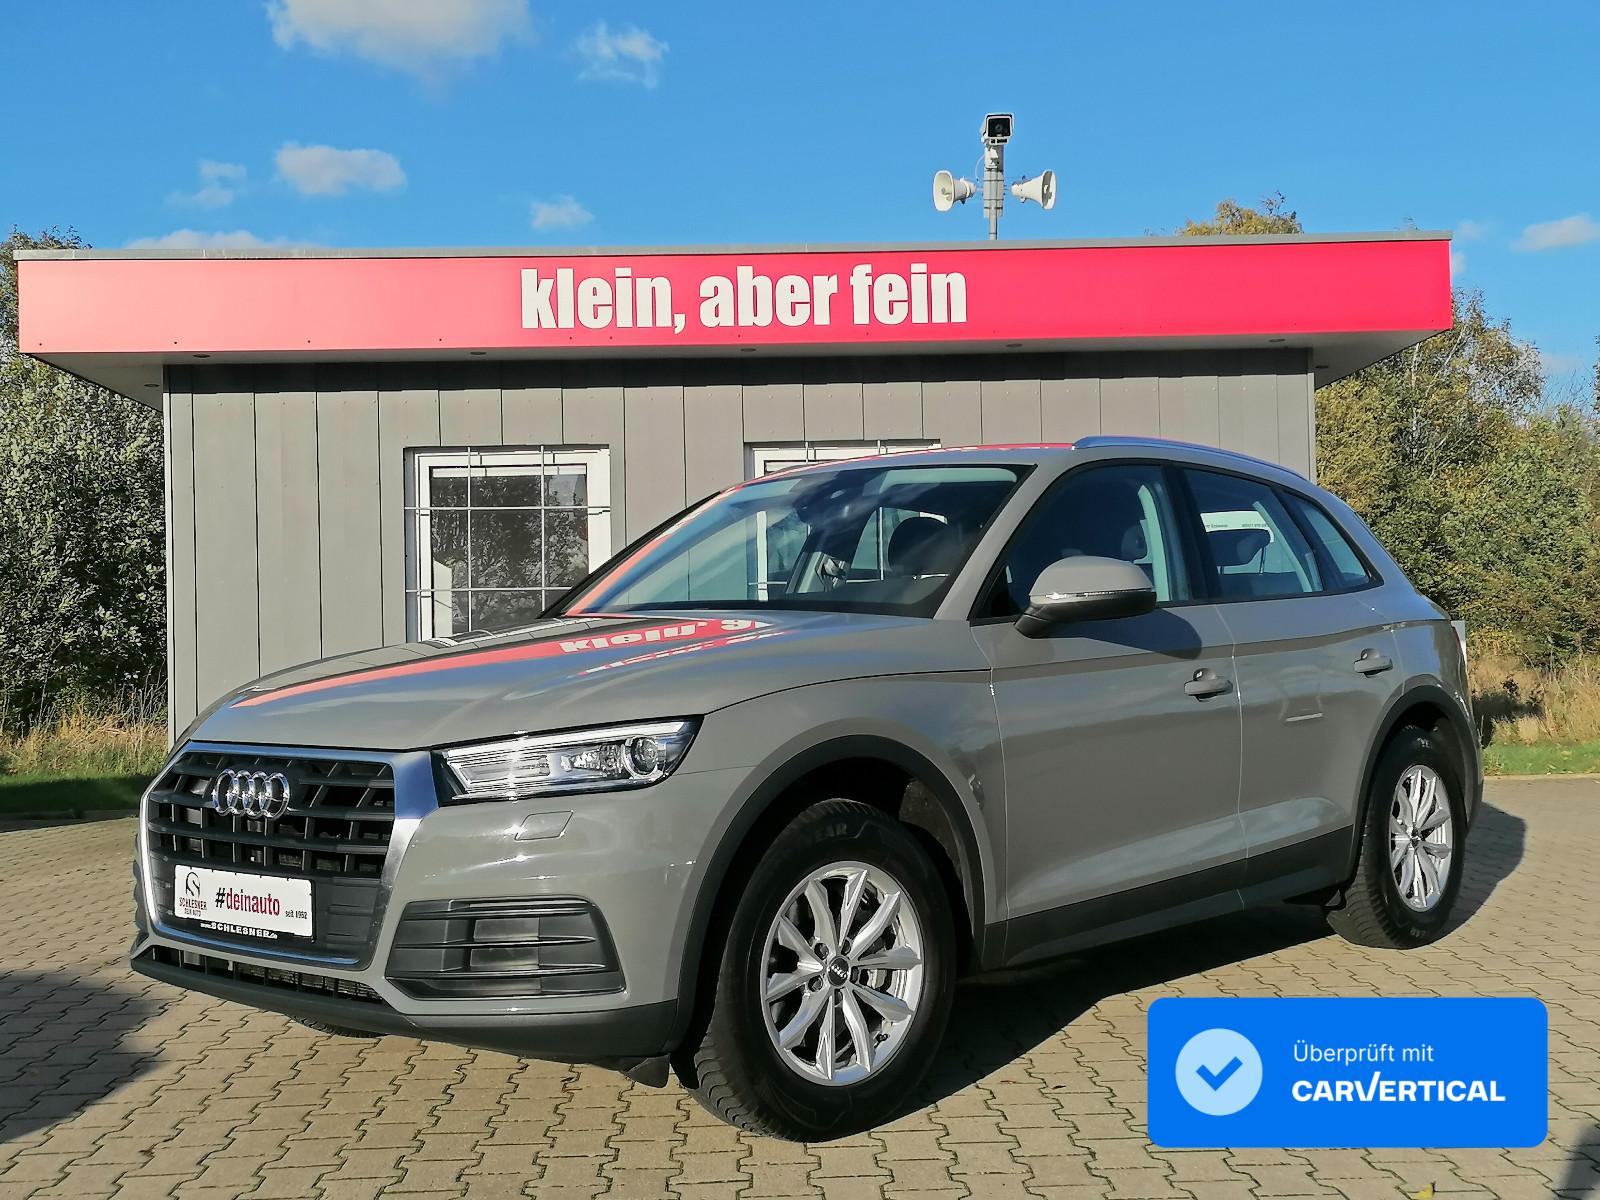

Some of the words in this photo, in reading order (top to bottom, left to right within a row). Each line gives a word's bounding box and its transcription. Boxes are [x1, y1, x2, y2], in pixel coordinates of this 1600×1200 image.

[520, 267, 686, 335] klein,
[699, 265, 838, 327] aber
[849, 263, 967, 324] fein
[179, 896, 207, 911] SCHLESNER
[214, 887, 280, 916] #deinauto
